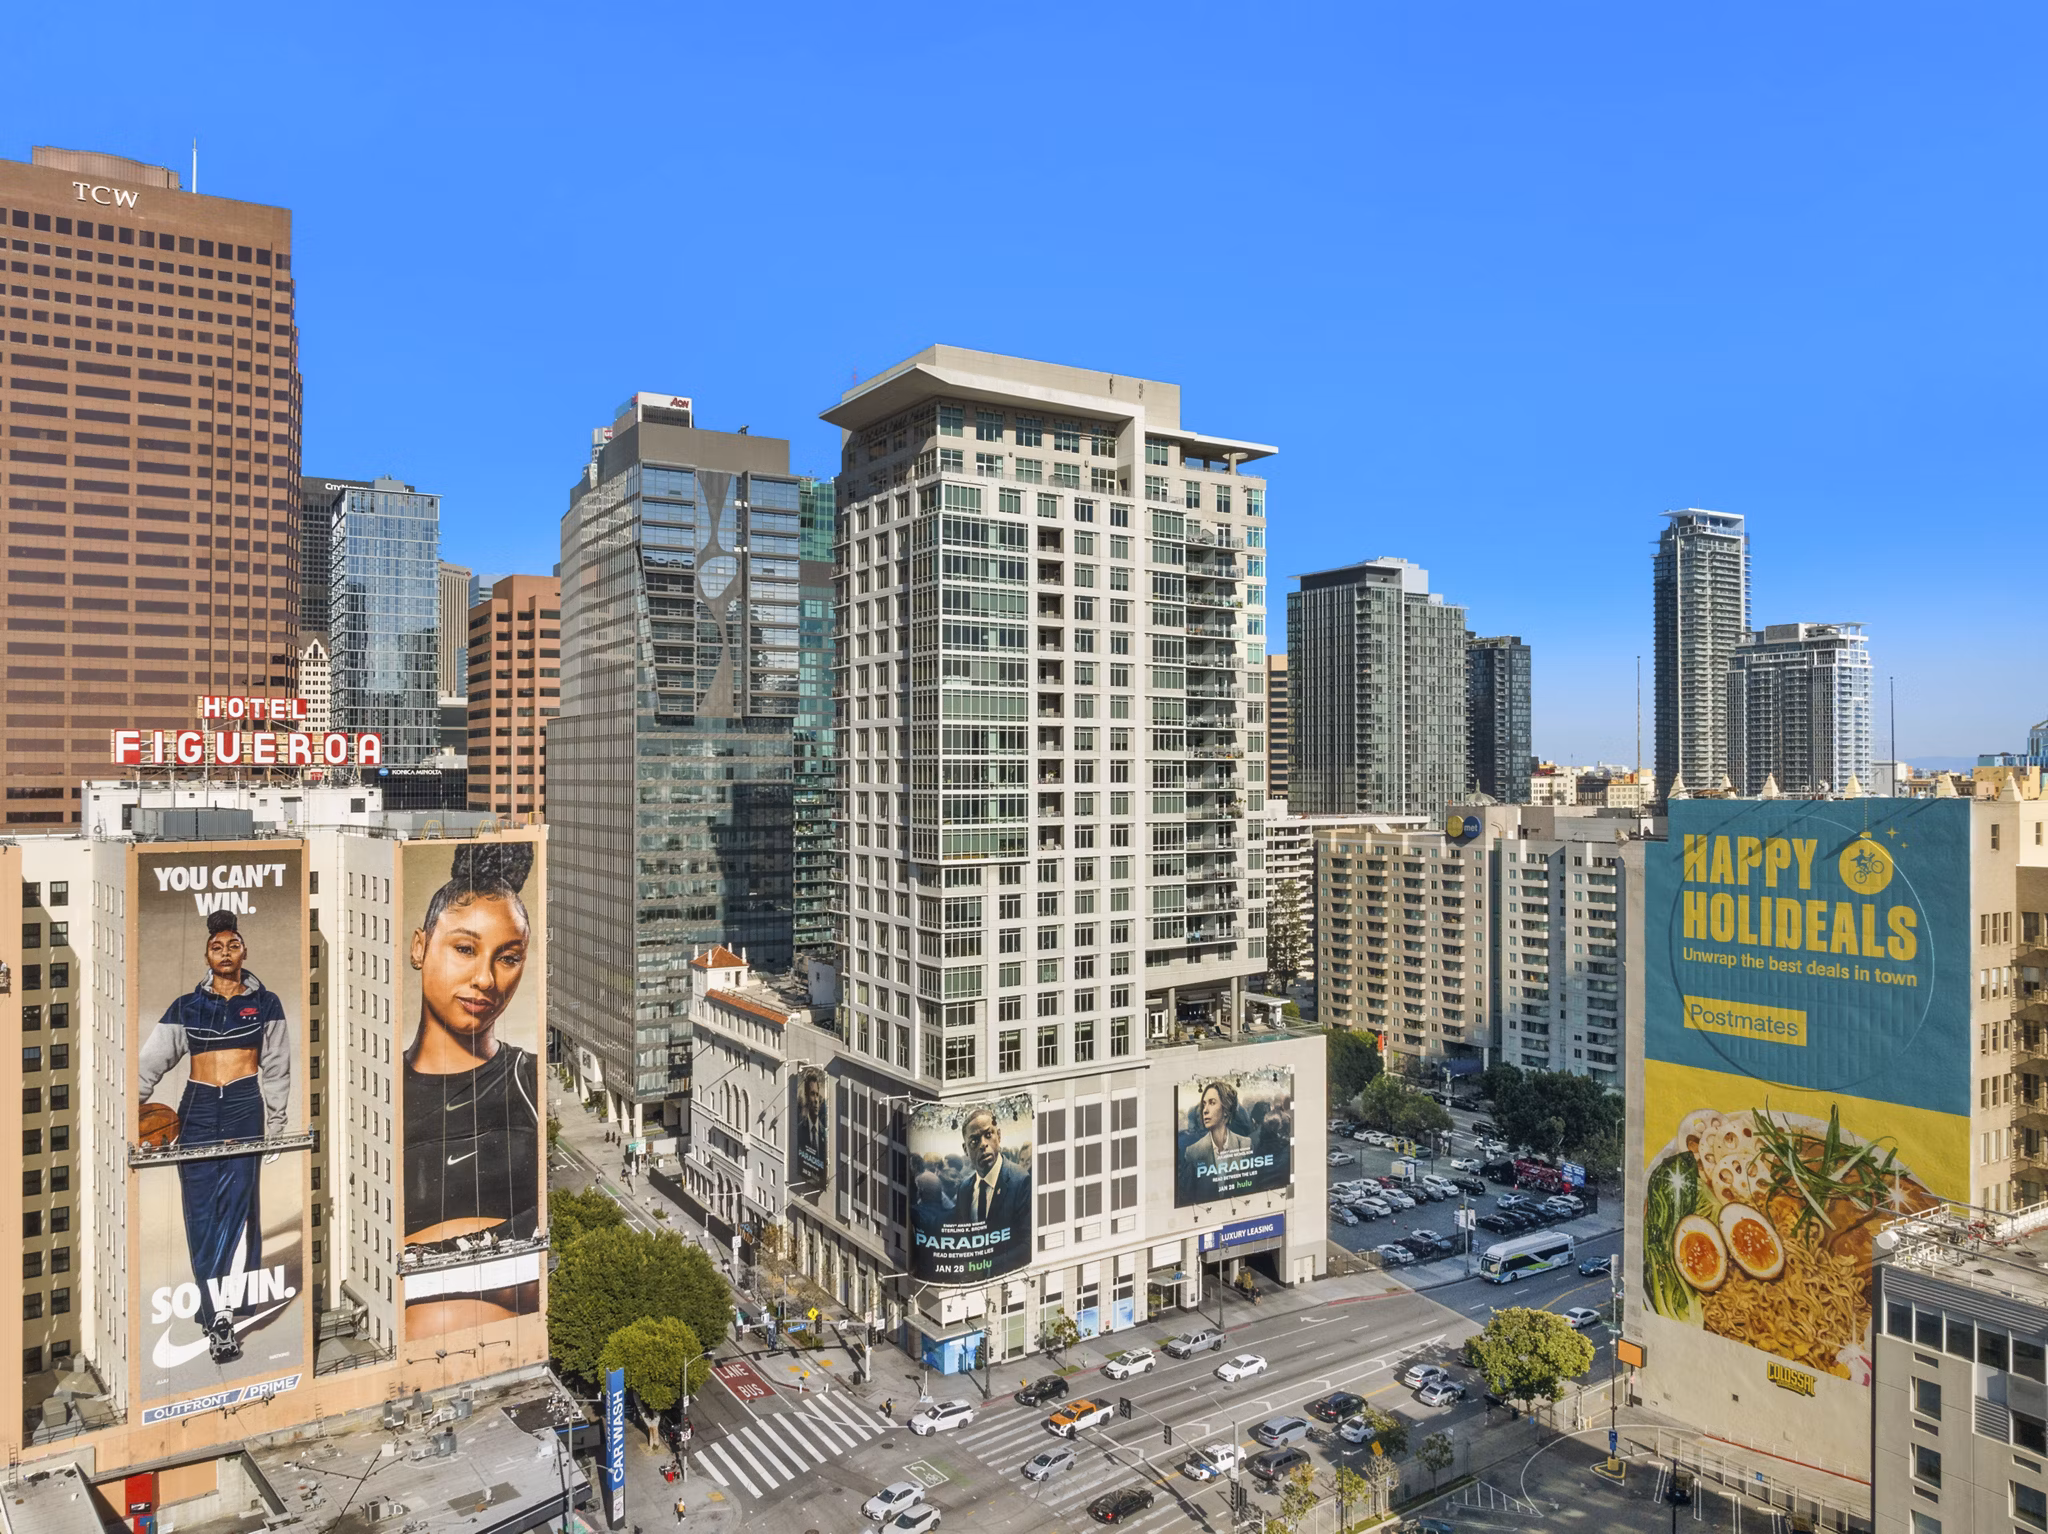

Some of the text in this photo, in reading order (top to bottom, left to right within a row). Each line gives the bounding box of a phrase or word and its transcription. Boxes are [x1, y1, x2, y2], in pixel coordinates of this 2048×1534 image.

[72, 181, 140, 209] TCW
[204, 697, 306, 719] HOTEL
[115, 731, 380, 764] FIGUEROA
[1464, 824, 1478, 832] met
[1683, 833, 1818, 890] HAPPY
[153, 864, 286, 891] YOU CAN'T
[194, 891, 257, 916] WIN.
[1683, 890, 1917, 961] HOLIDEALS
[1683, 947, 1917, 987] Unwrap the best deals in town
[1691, 1004, 1799, 1037] Postmates
[1196, 1154, 1274, 1178] PARADISE
[1236, 1180, 1252, 1188] hulu
[916, 1227, 1011, 1250] PARADISE
[1221, 1229, 1246, 1242] LUXURY
[1246, 1223, 1274, 1236] LEASING
[984, 1247, 994, 1255] LIES
[935, 1259, 993, 1273] JAN 28 hulu
[151, 1265, 296, 1324] SO WIN.
[716, 1364, 749, 1379] LANE
[1767, 1361, 1816, 1396] COLOSSAL
[154, 1377, 296, 1419] OUTFRONT PRIME
[737, 1383, 765, 1398] BUS
[613, 1390, 623, 1445] WASH
[613, 1443, 624, 1482] CAR
